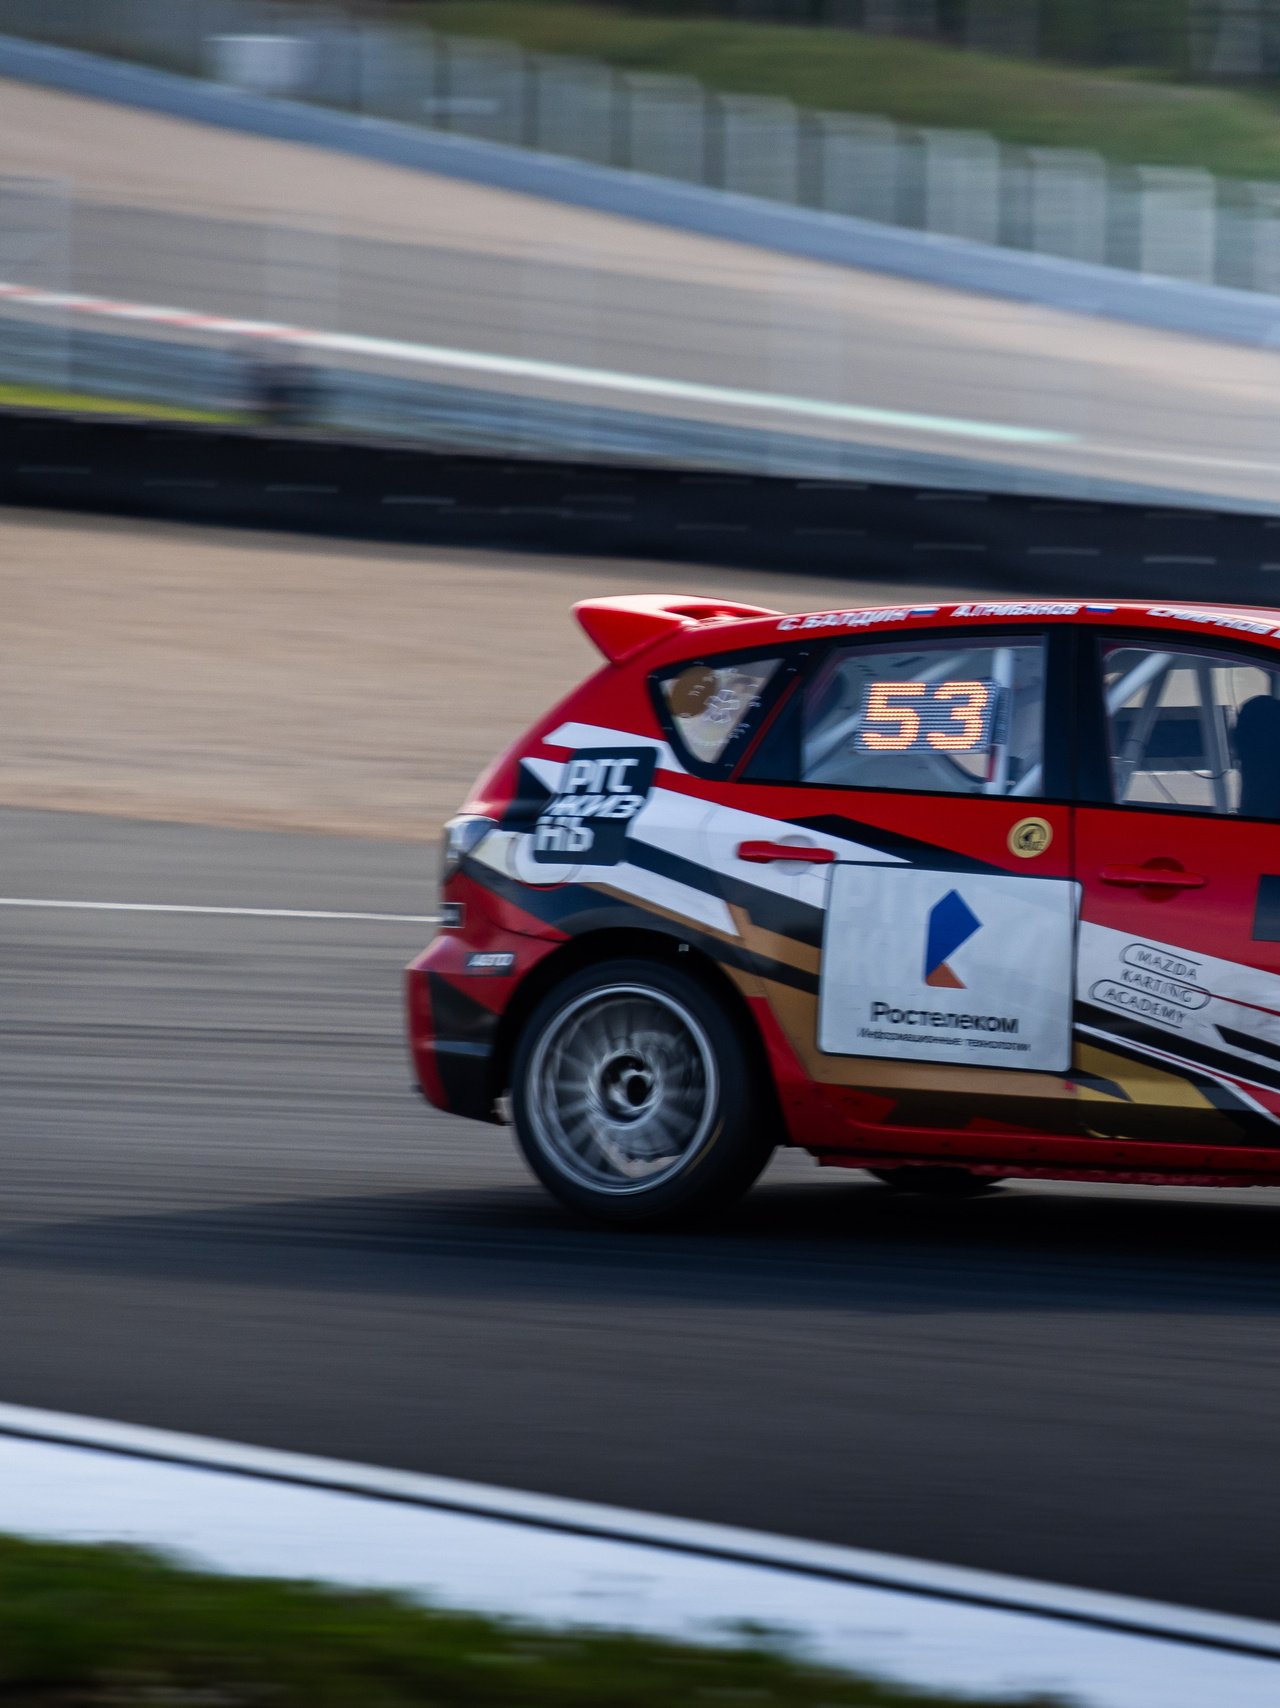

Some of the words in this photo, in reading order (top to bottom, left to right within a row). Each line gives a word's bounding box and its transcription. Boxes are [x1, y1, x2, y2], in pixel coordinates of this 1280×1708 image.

[862, 681, 989, 750] 53
[1135, 950, 1198, 981] MAZDA
[1121, 968, 1193, 1003] KARTING
[869, 1001, 1019, 1034] Ростелеком
[1103, 988, 1187, 1023] ACADEMY
